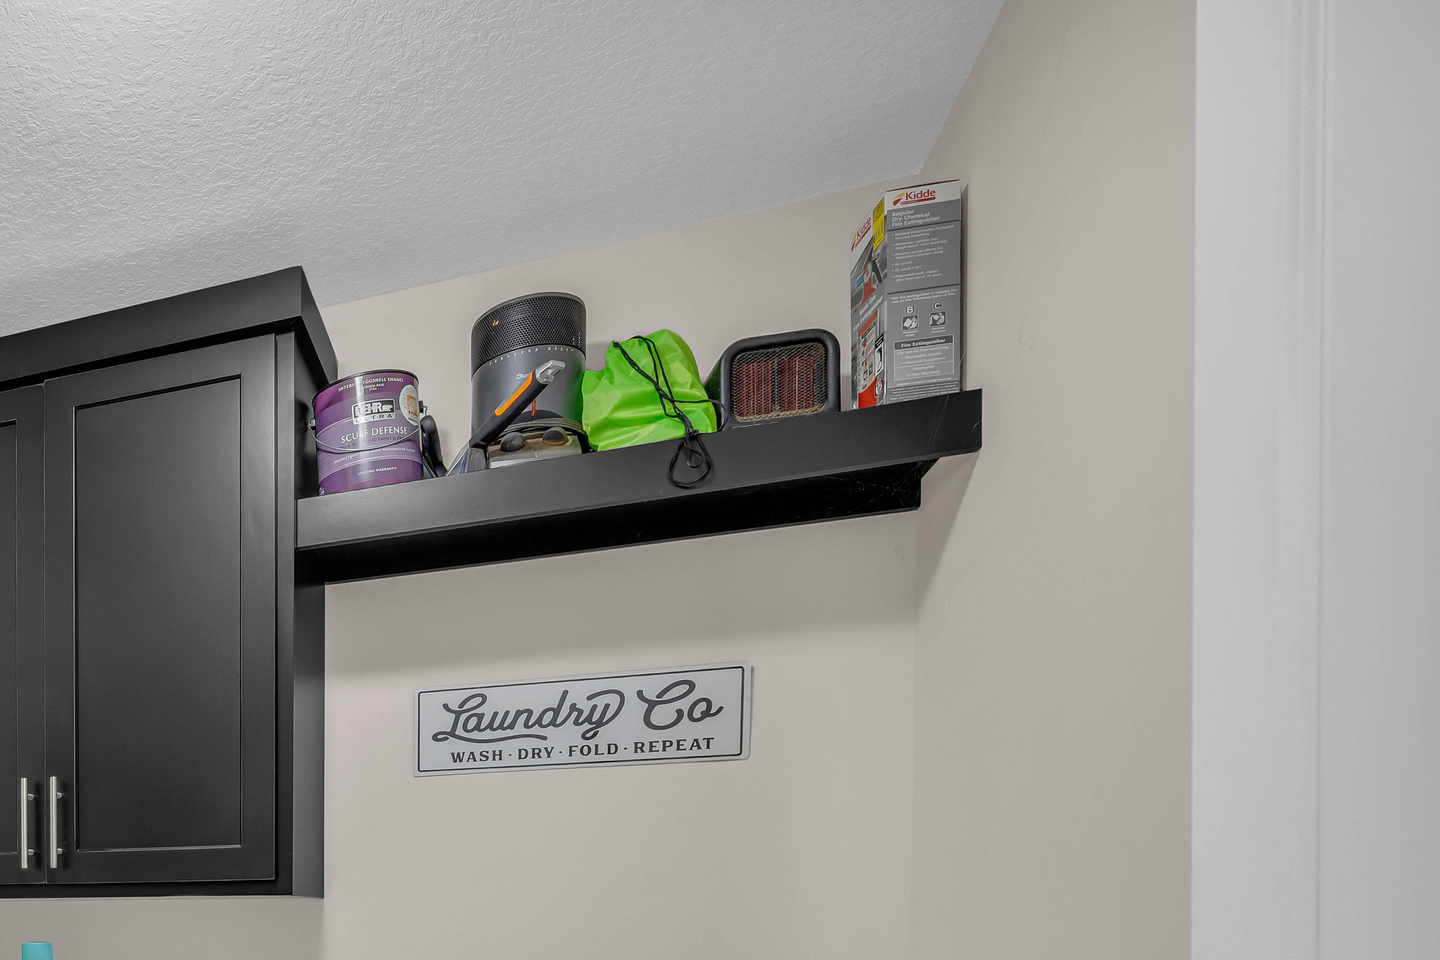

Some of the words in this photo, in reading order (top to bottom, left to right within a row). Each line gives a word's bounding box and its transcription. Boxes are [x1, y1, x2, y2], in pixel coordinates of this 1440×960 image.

[905, 189, 936, 201] Kidde
[891, 210, 914, 218] Regular
[891, 216, 903, 224] Dry
[904, 212, 930, 221] Chemical
[904, 216, 941, 226] Extinguisher
[906, 305, 913, 313] B
[934, 301, 940, 309] C
[911, 337, 946, 347] Extinguisher
[341, 429, 369, 444] SCUFF
[371, 426, 408, 436] DEFENSE
[431, 689, 625, 743] Laundry
[636, 679, 724, 731] Co
[450, 749, 503, 763] WASH
[517, 746, 555, 760] DRY
[568, 743, 618, 757] FOLD
[633, 737, 715, 754] REPEAT
